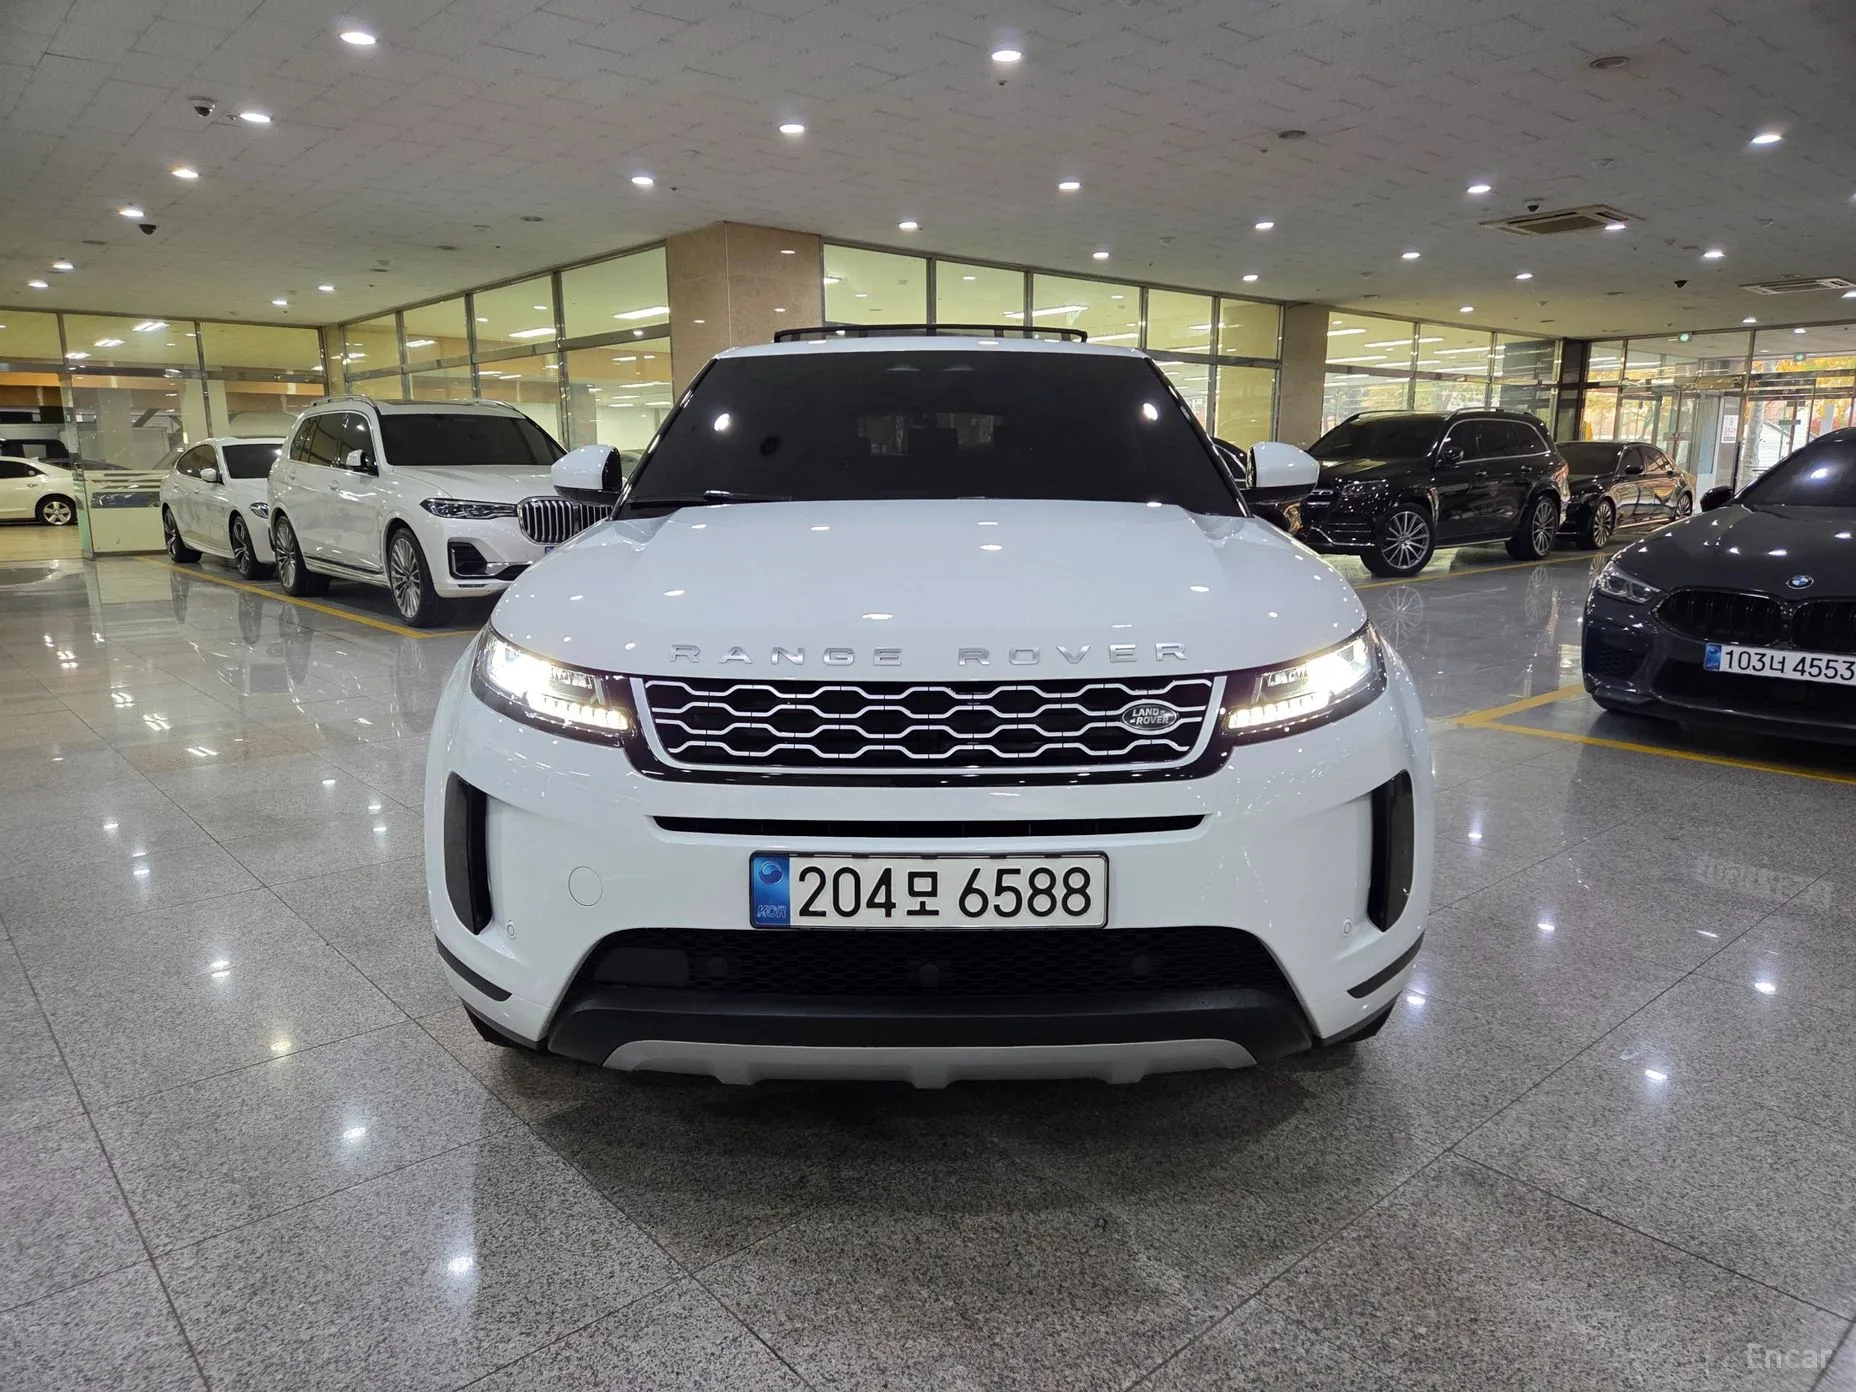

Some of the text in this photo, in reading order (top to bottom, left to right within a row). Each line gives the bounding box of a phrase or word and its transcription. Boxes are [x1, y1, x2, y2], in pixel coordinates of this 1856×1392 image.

[669, 642, 1188, 667] RANGE ROVER
[1725, 649, 1856, 681] 103너 4553
[1132, 708, 1160, 717] LAND
[1135, 715, 1169, 725] ROVER
[798, 865, 1092, 918] 204모 6588
[756, 904, 787, 918] KOR
